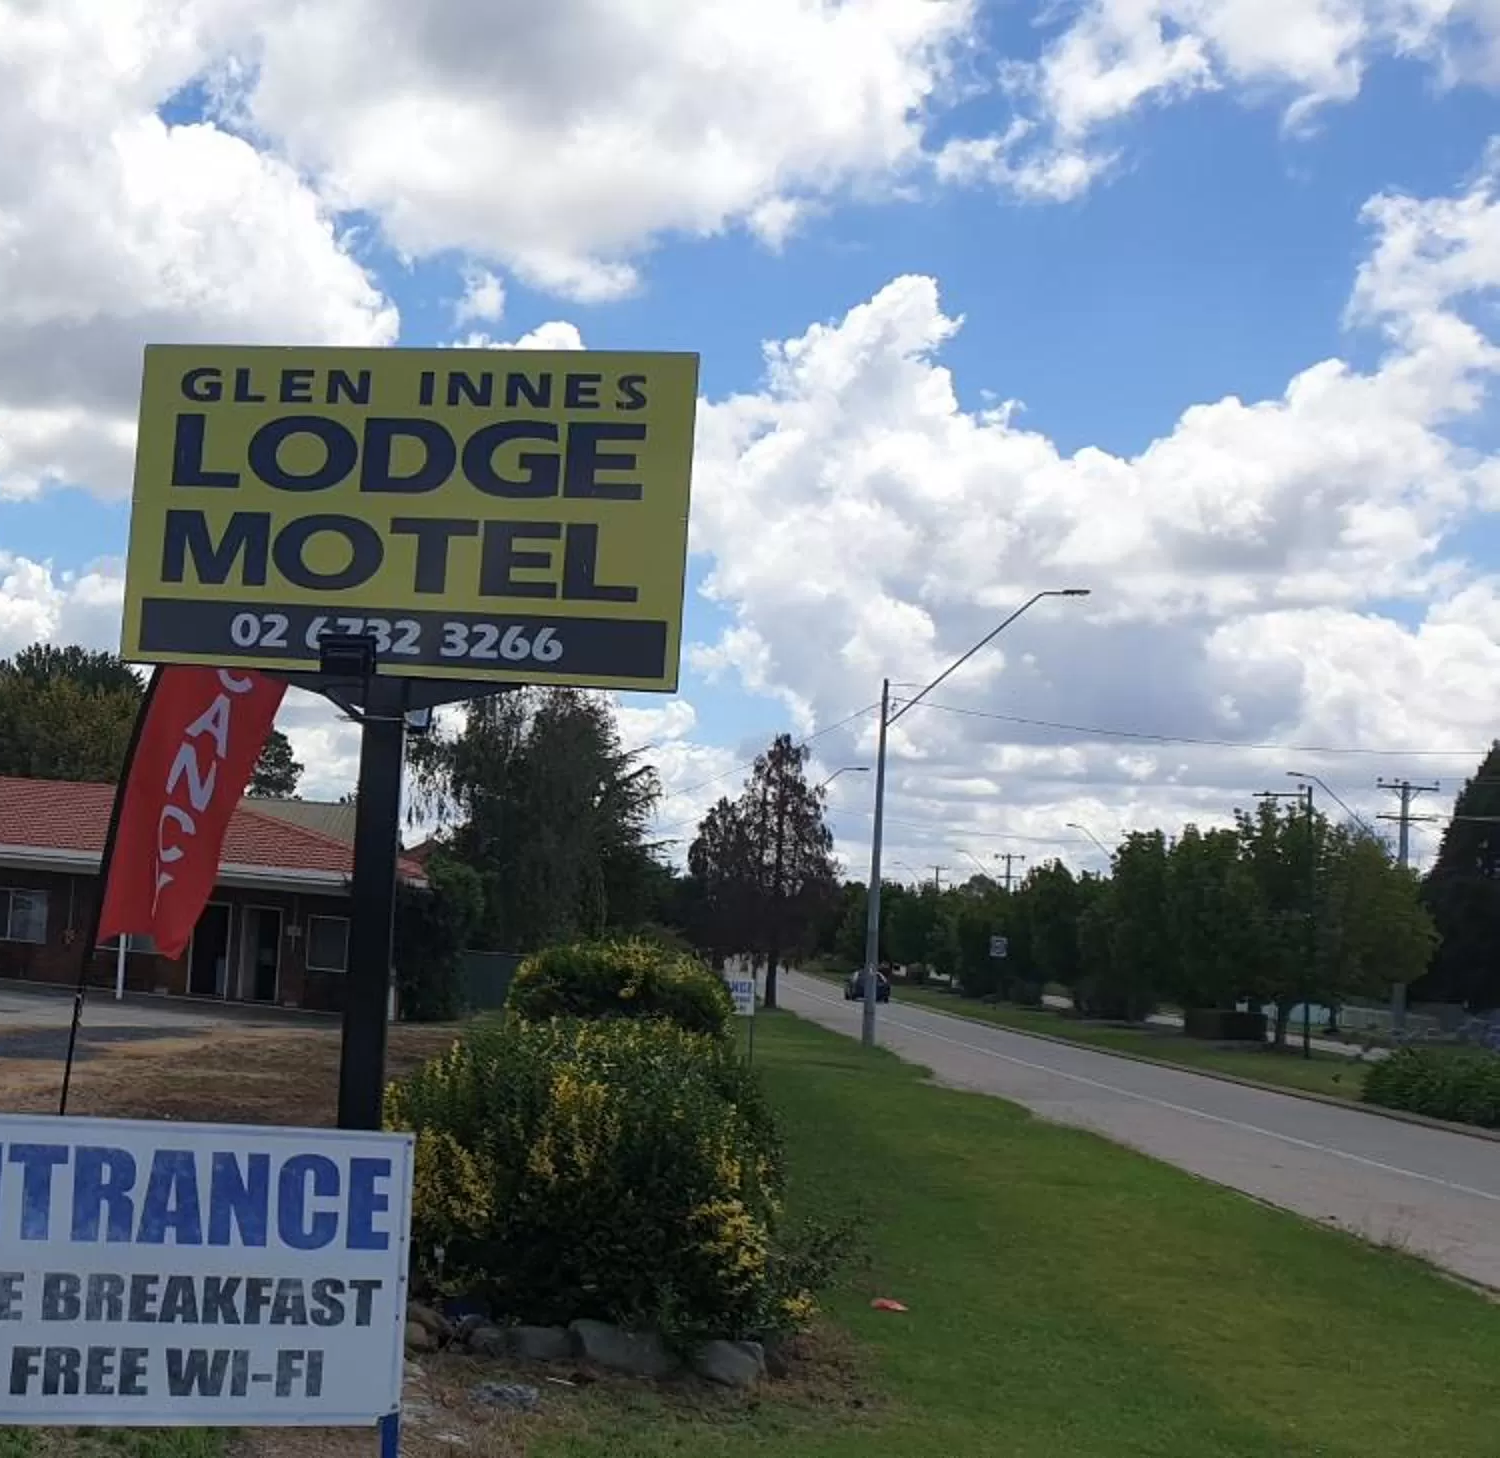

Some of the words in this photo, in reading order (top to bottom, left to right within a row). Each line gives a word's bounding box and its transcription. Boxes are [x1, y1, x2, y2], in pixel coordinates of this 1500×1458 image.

[181, 367, 372, 405] GLEN
[419, 370, 649, 411] INNES
[171, 413, 647, 500] LODGE
[161, 509, 639, 603] MOTEL
[230, 612, 288, 649] 02
[439, 621, 564, 662] 3266
[41, 1271, 382, 1327] BREAKFAST
[9, 1345, 149, 1397] FREE
[165, 1348, 325, 1398] WI-FI
